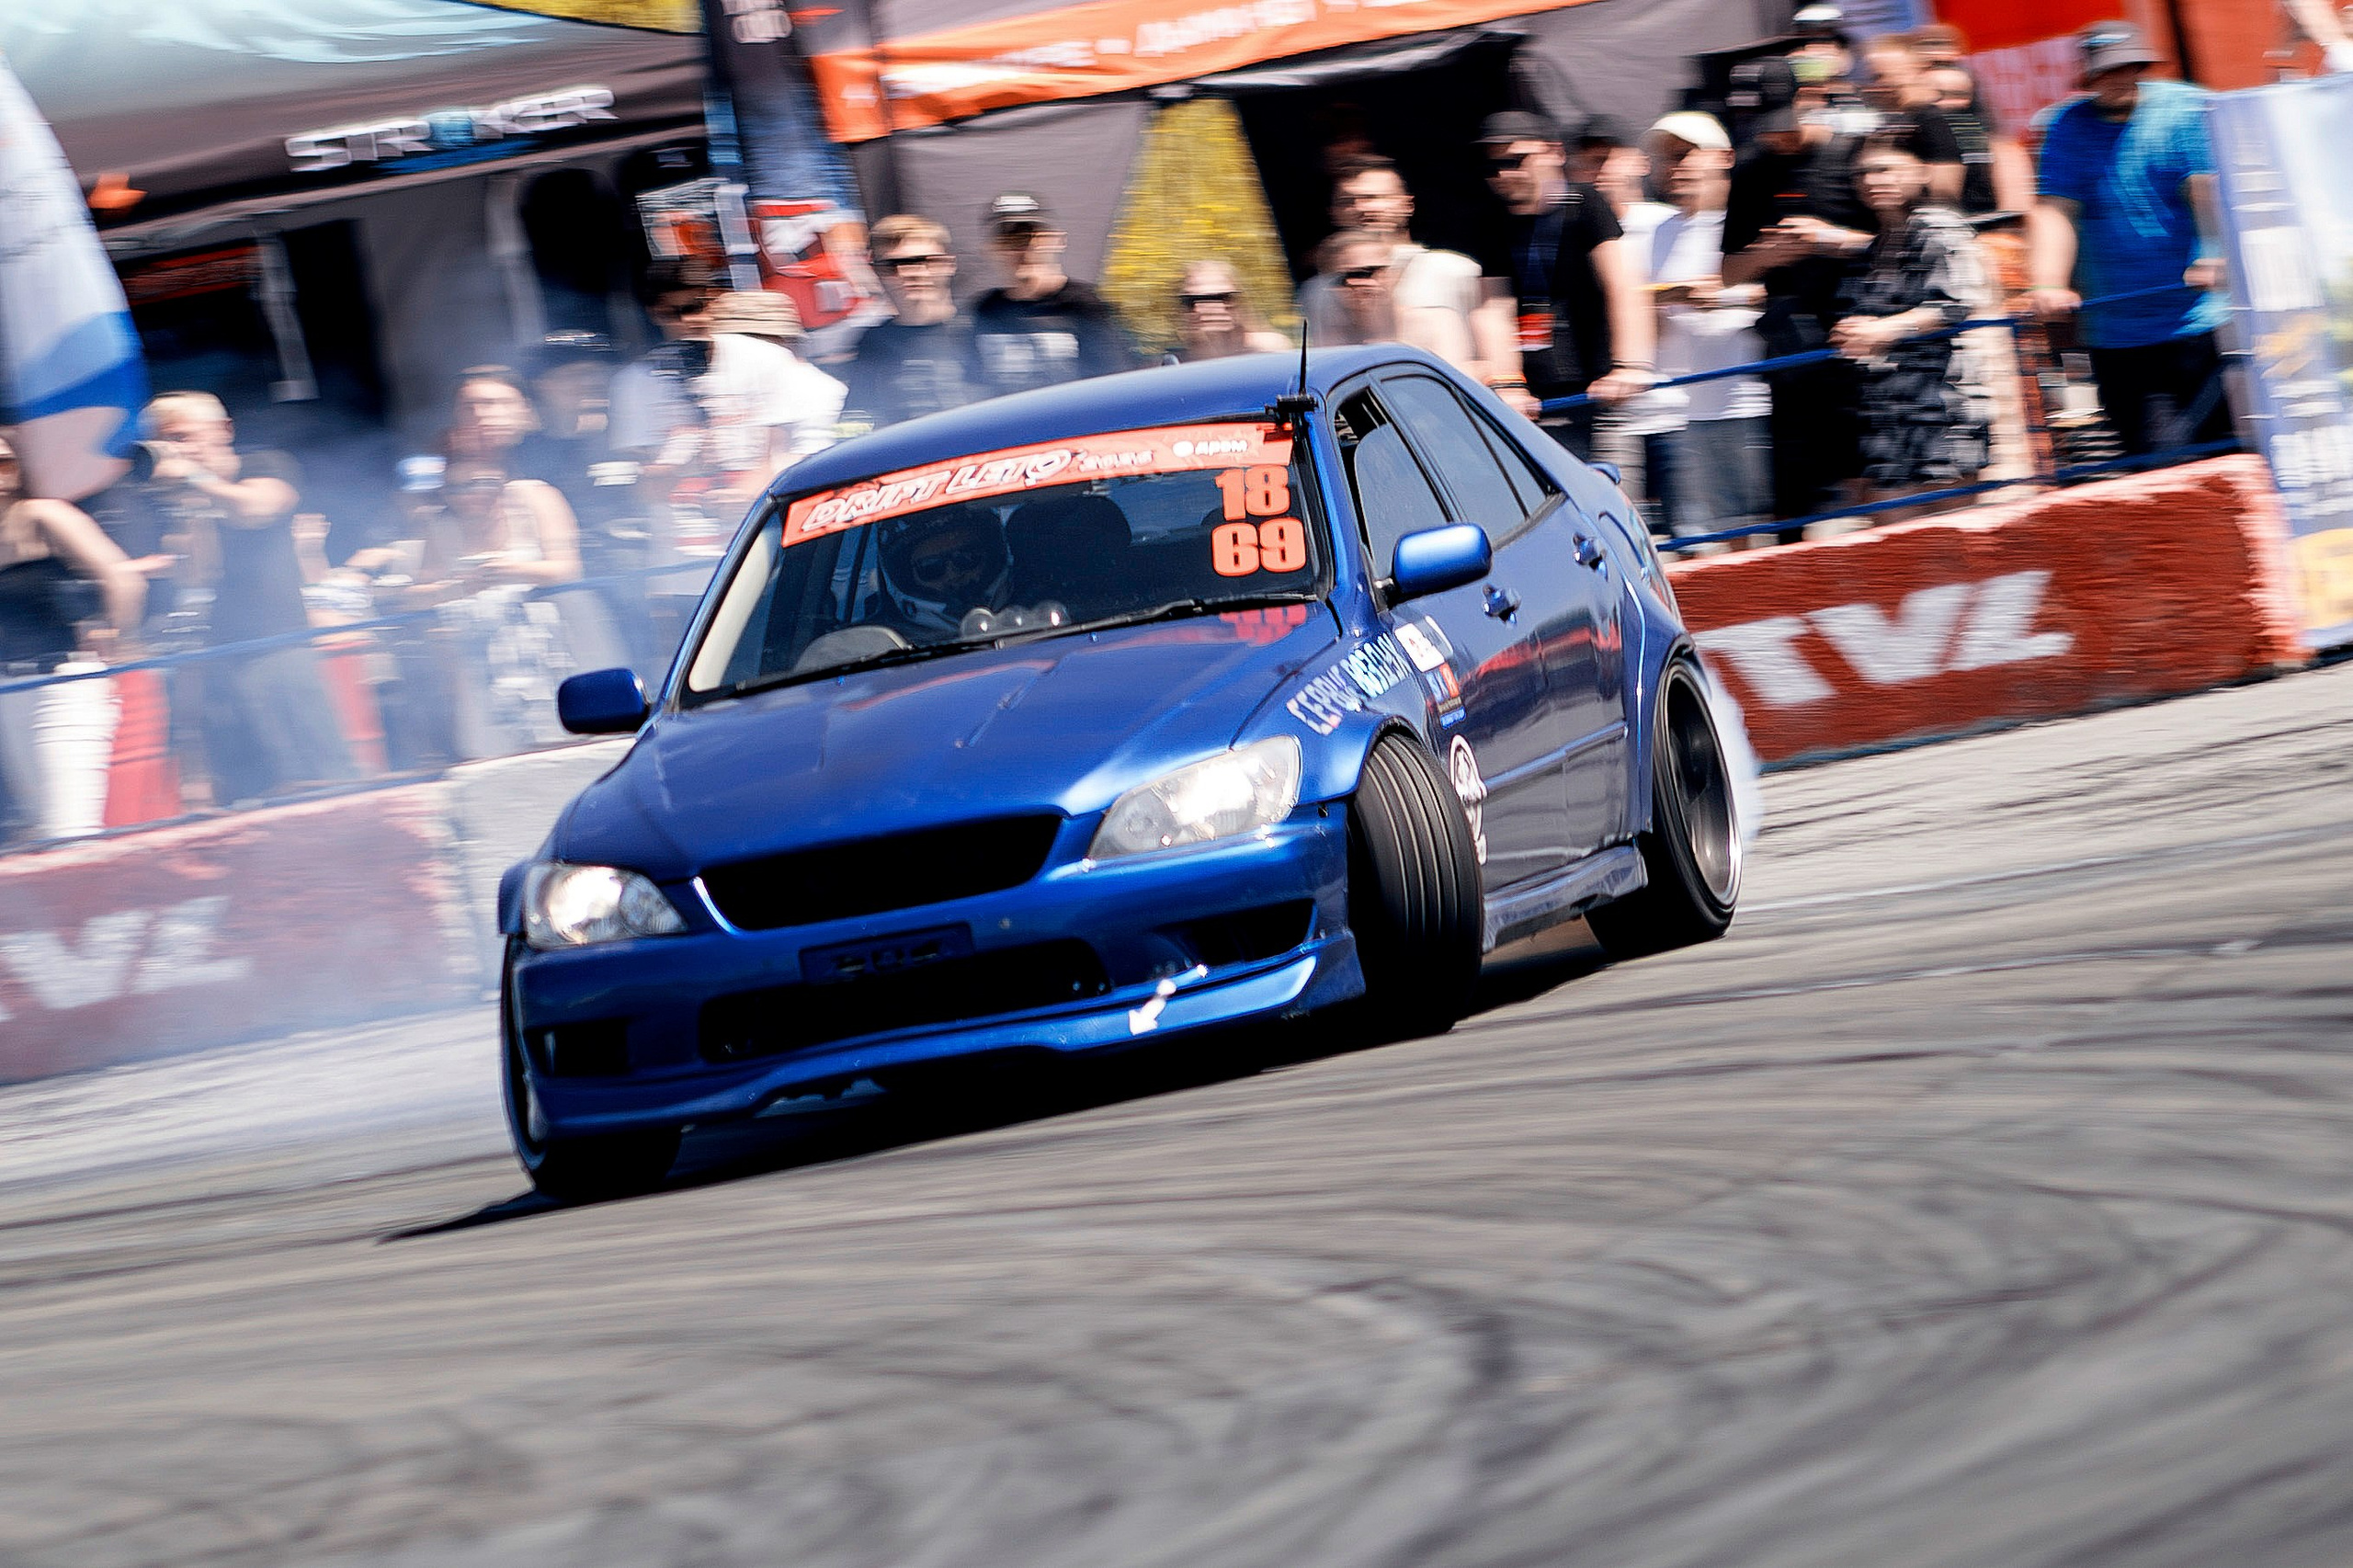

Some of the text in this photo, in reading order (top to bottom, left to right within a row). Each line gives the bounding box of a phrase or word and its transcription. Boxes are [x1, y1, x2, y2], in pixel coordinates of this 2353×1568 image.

[285, 87, 619, 173] STROKER
[1214, 464, 1291, 521] 18
[1211, 517, 1307, 577] 69
[0, 895, 254, 1023] VL
